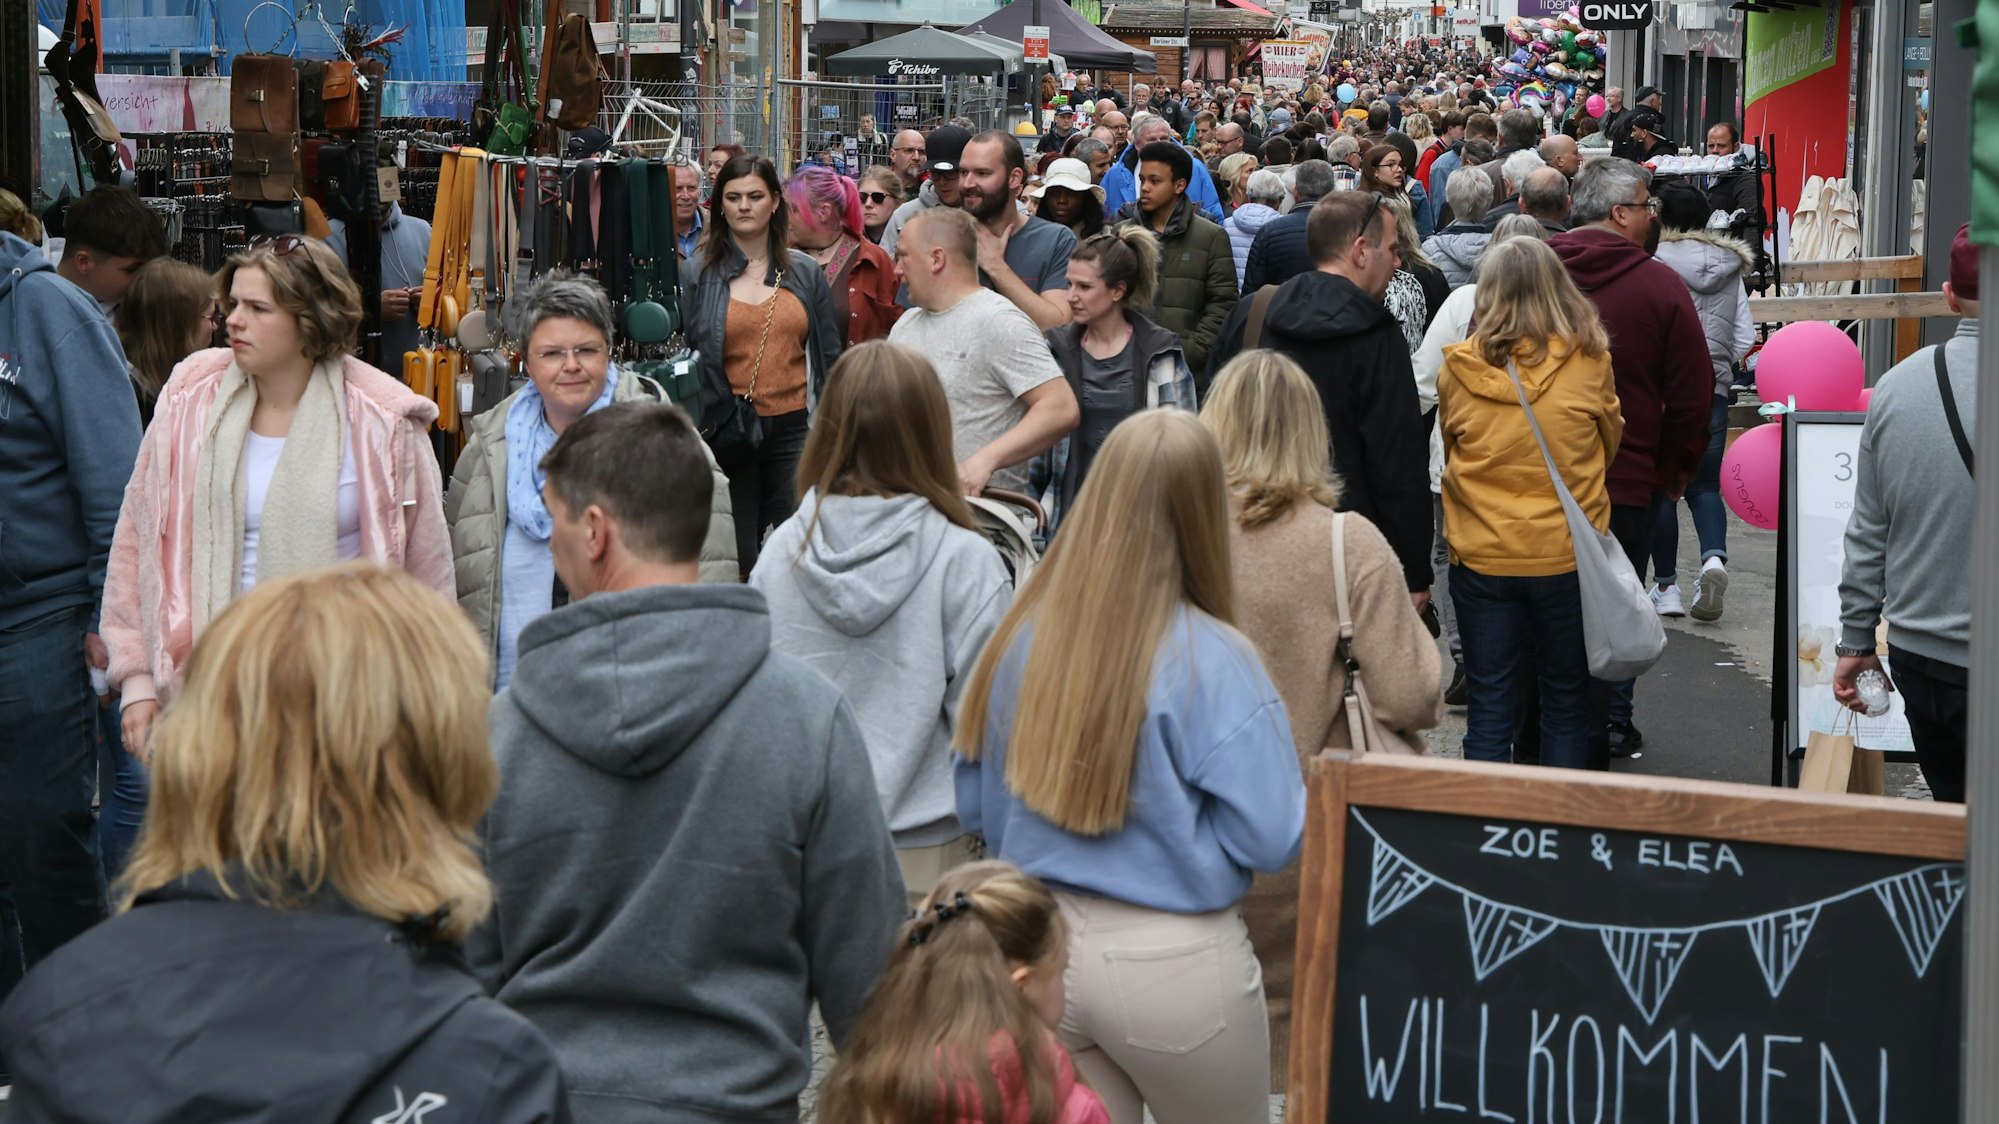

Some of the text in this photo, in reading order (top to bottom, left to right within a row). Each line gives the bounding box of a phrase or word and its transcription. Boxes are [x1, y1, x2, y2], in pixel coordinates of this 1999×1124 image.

[1584, 3, 1648, 20] ONLY
[1273, 46, 1297, 56] HIER
[902, 64, 940, 75] Tchibo
[1263, 60, 1305, 78] Reibekuchen
[1834, 452, 1853, 482] 3
[1479, 825, 1745, 877] ZOE & ELEA
[1359, 994, 1889, 1124] WILLKOMMEN
